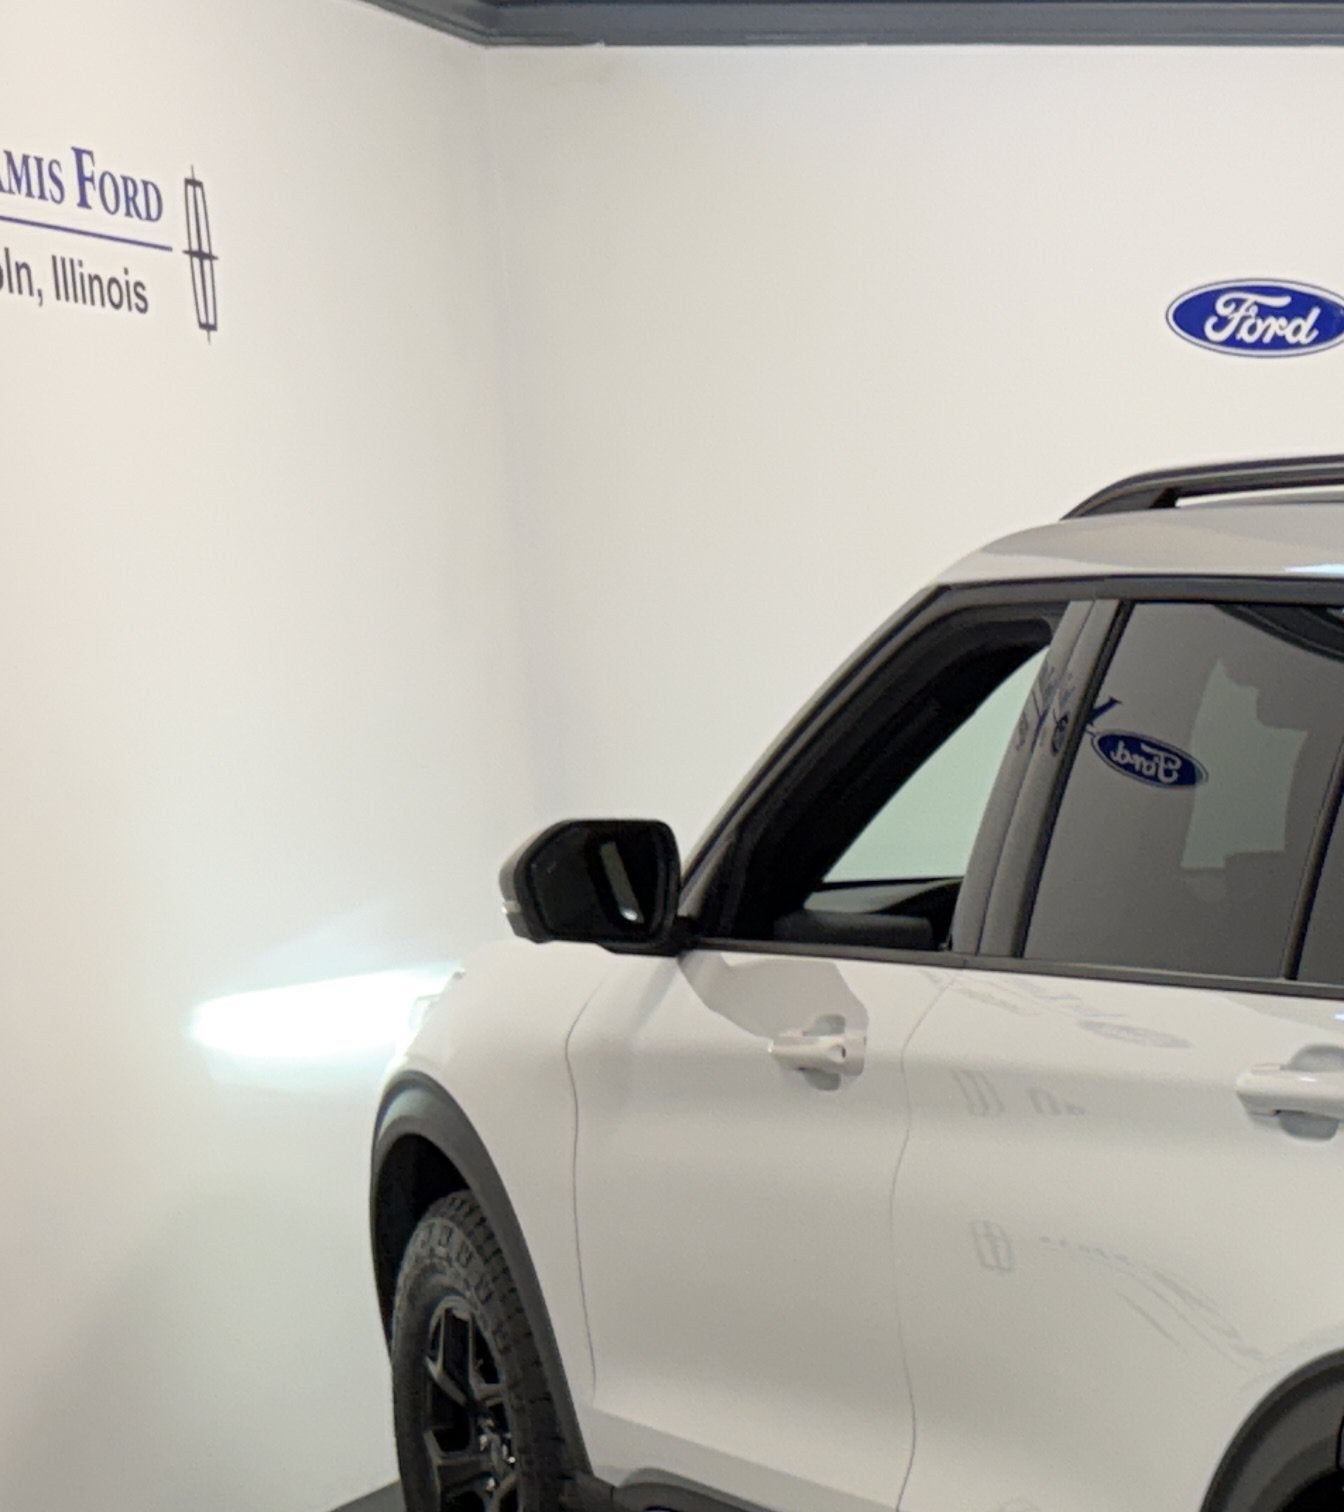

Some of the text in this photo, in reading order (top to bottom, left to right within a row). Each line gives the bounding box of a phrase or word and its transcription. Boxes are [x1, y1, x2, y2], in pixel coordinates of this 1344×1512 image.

[71, 146, 163, 222] FORD
[0, 247, 149, 314] ln, Illinois
[1203, 291, 1320, 345] Ford
